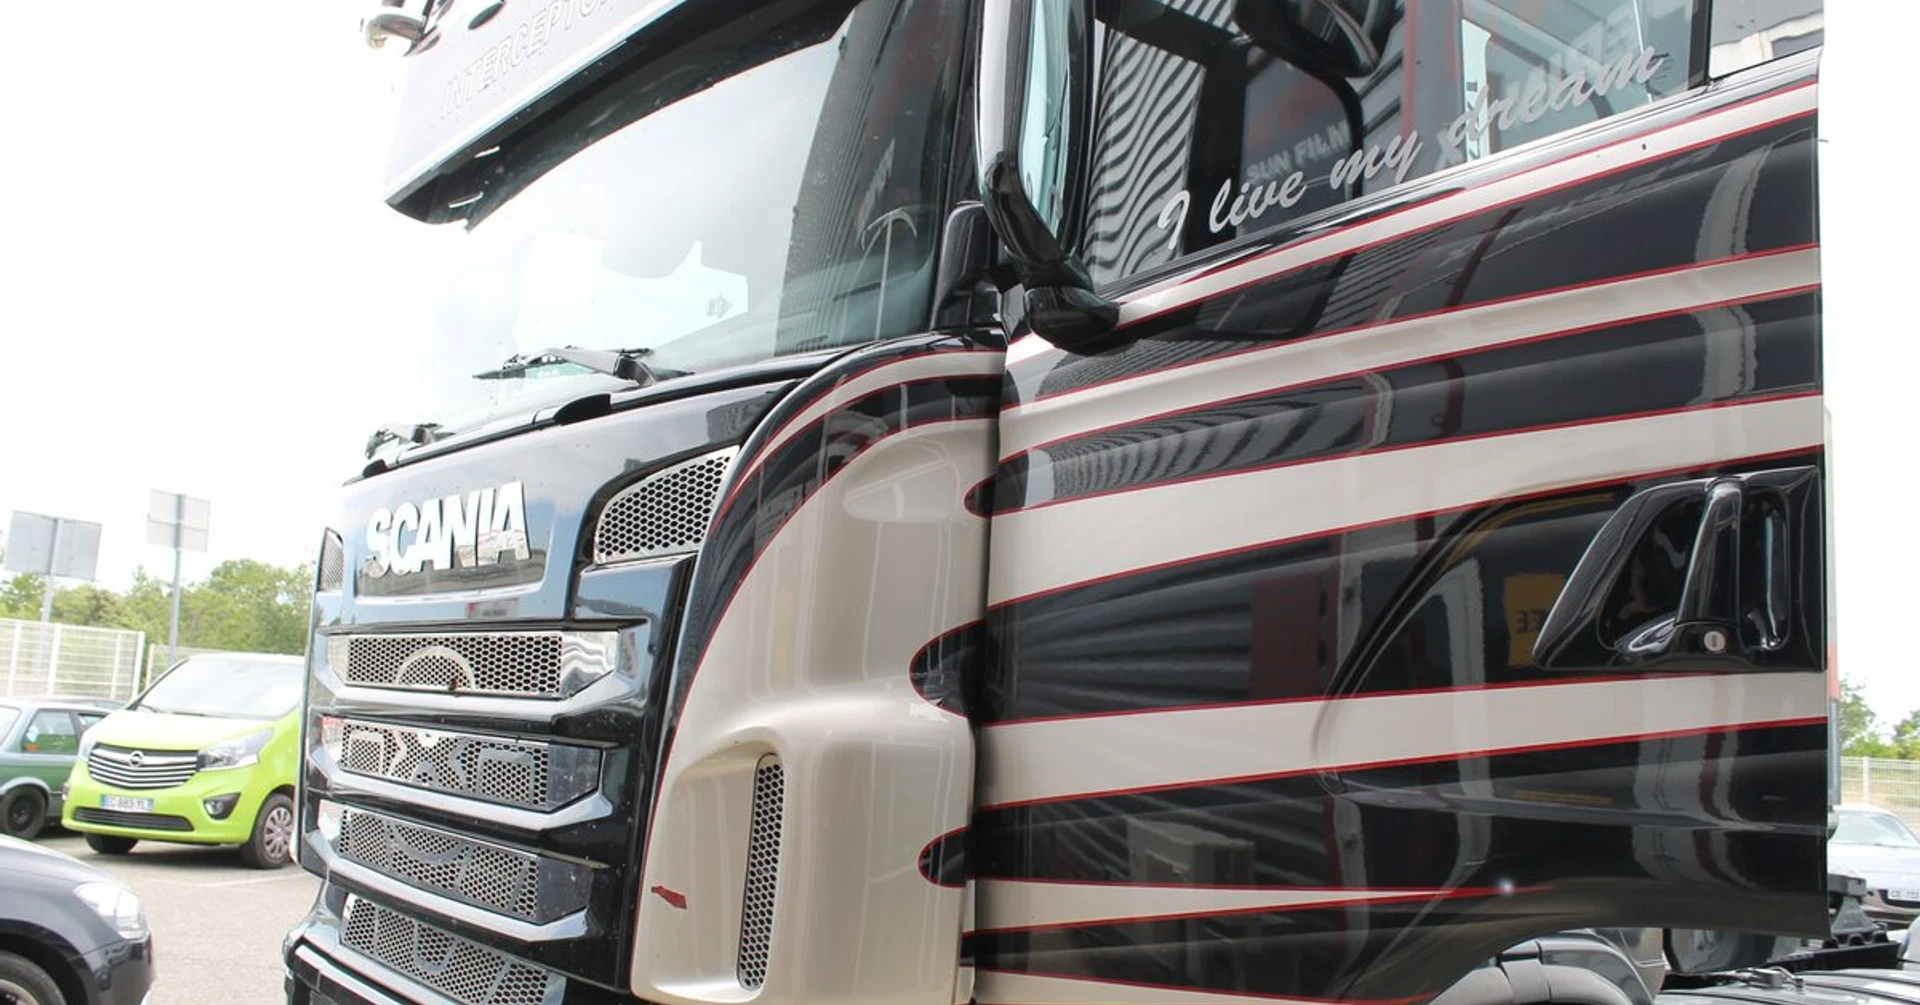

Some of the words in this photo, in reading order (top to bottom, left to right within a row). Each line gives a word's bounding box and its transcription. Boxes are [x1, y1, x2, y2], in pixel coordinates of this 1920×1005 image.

[1209, 178, 1307, 233] live
[1330, 130, 1422, 184] my
[1448, 45, 1666, 142] dream
[1246, 151, 1292, 182] SUN
[1294, 119, 1352, 168] FILM
[365, 480, 532, 578] SCANIA
